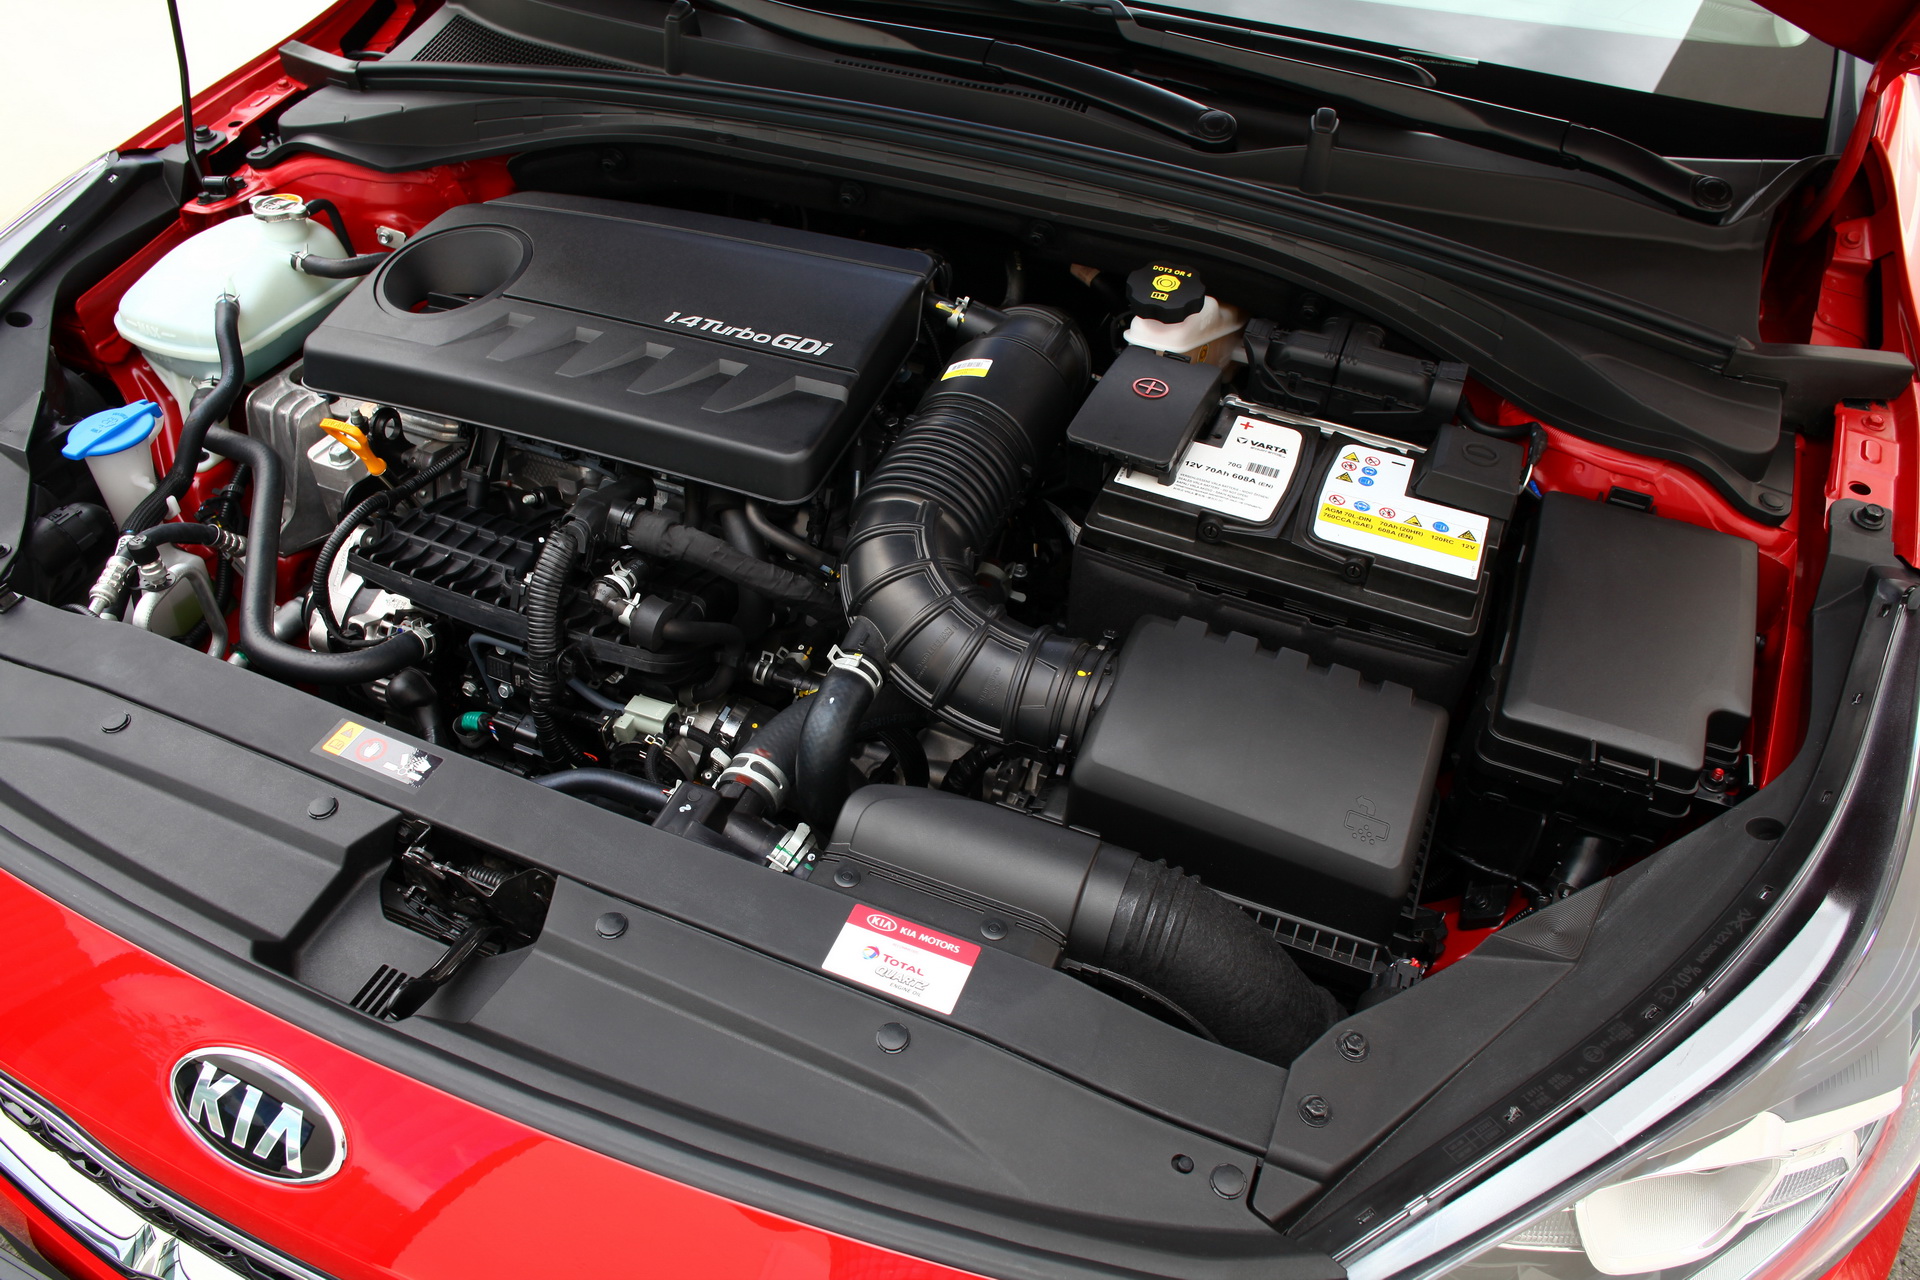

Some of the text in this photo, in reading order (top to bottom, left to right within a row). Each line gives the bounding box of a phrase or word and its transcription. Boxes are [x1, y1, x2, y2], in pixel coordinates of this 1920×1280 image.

[1152, 265, 1173, 274] DOT3
[1174, 269, 1186, 277] OR
[663, 310, 835, 356] 1.4 Turbo GDi
[1251, 440, 1287, 454] VARTA
[1185, 460, 1274, 490] 12V 70Ah 608A (EN)
[1227, 461, 1242, 469] 70G
[1323, 512, 1414, 541] 760CCA (SAE) 608A (EN)
[1324, 506, 1344, 516] AGM
[1344, 511, 1372, 522] 70L-DIN
[1379, 520, 1399, 530] 70Ah
[1399, 525, 1424, 537] (20HR)
[1431, 534, 1455, 545] 120RC
[871, 916, 892, 930] KIA
[899, 926, 917, 939] KIA
[917, 933, 961, 954] MOTORS
[1713, 925, 1734, 948] 12V
[883, 953, 925, 977] TOTAL
[874, 966, 930, 991] QUARTZ
[889, 982, 921, 998] ENGINE OIL
[188, 1060, 305, 1174] KIA
